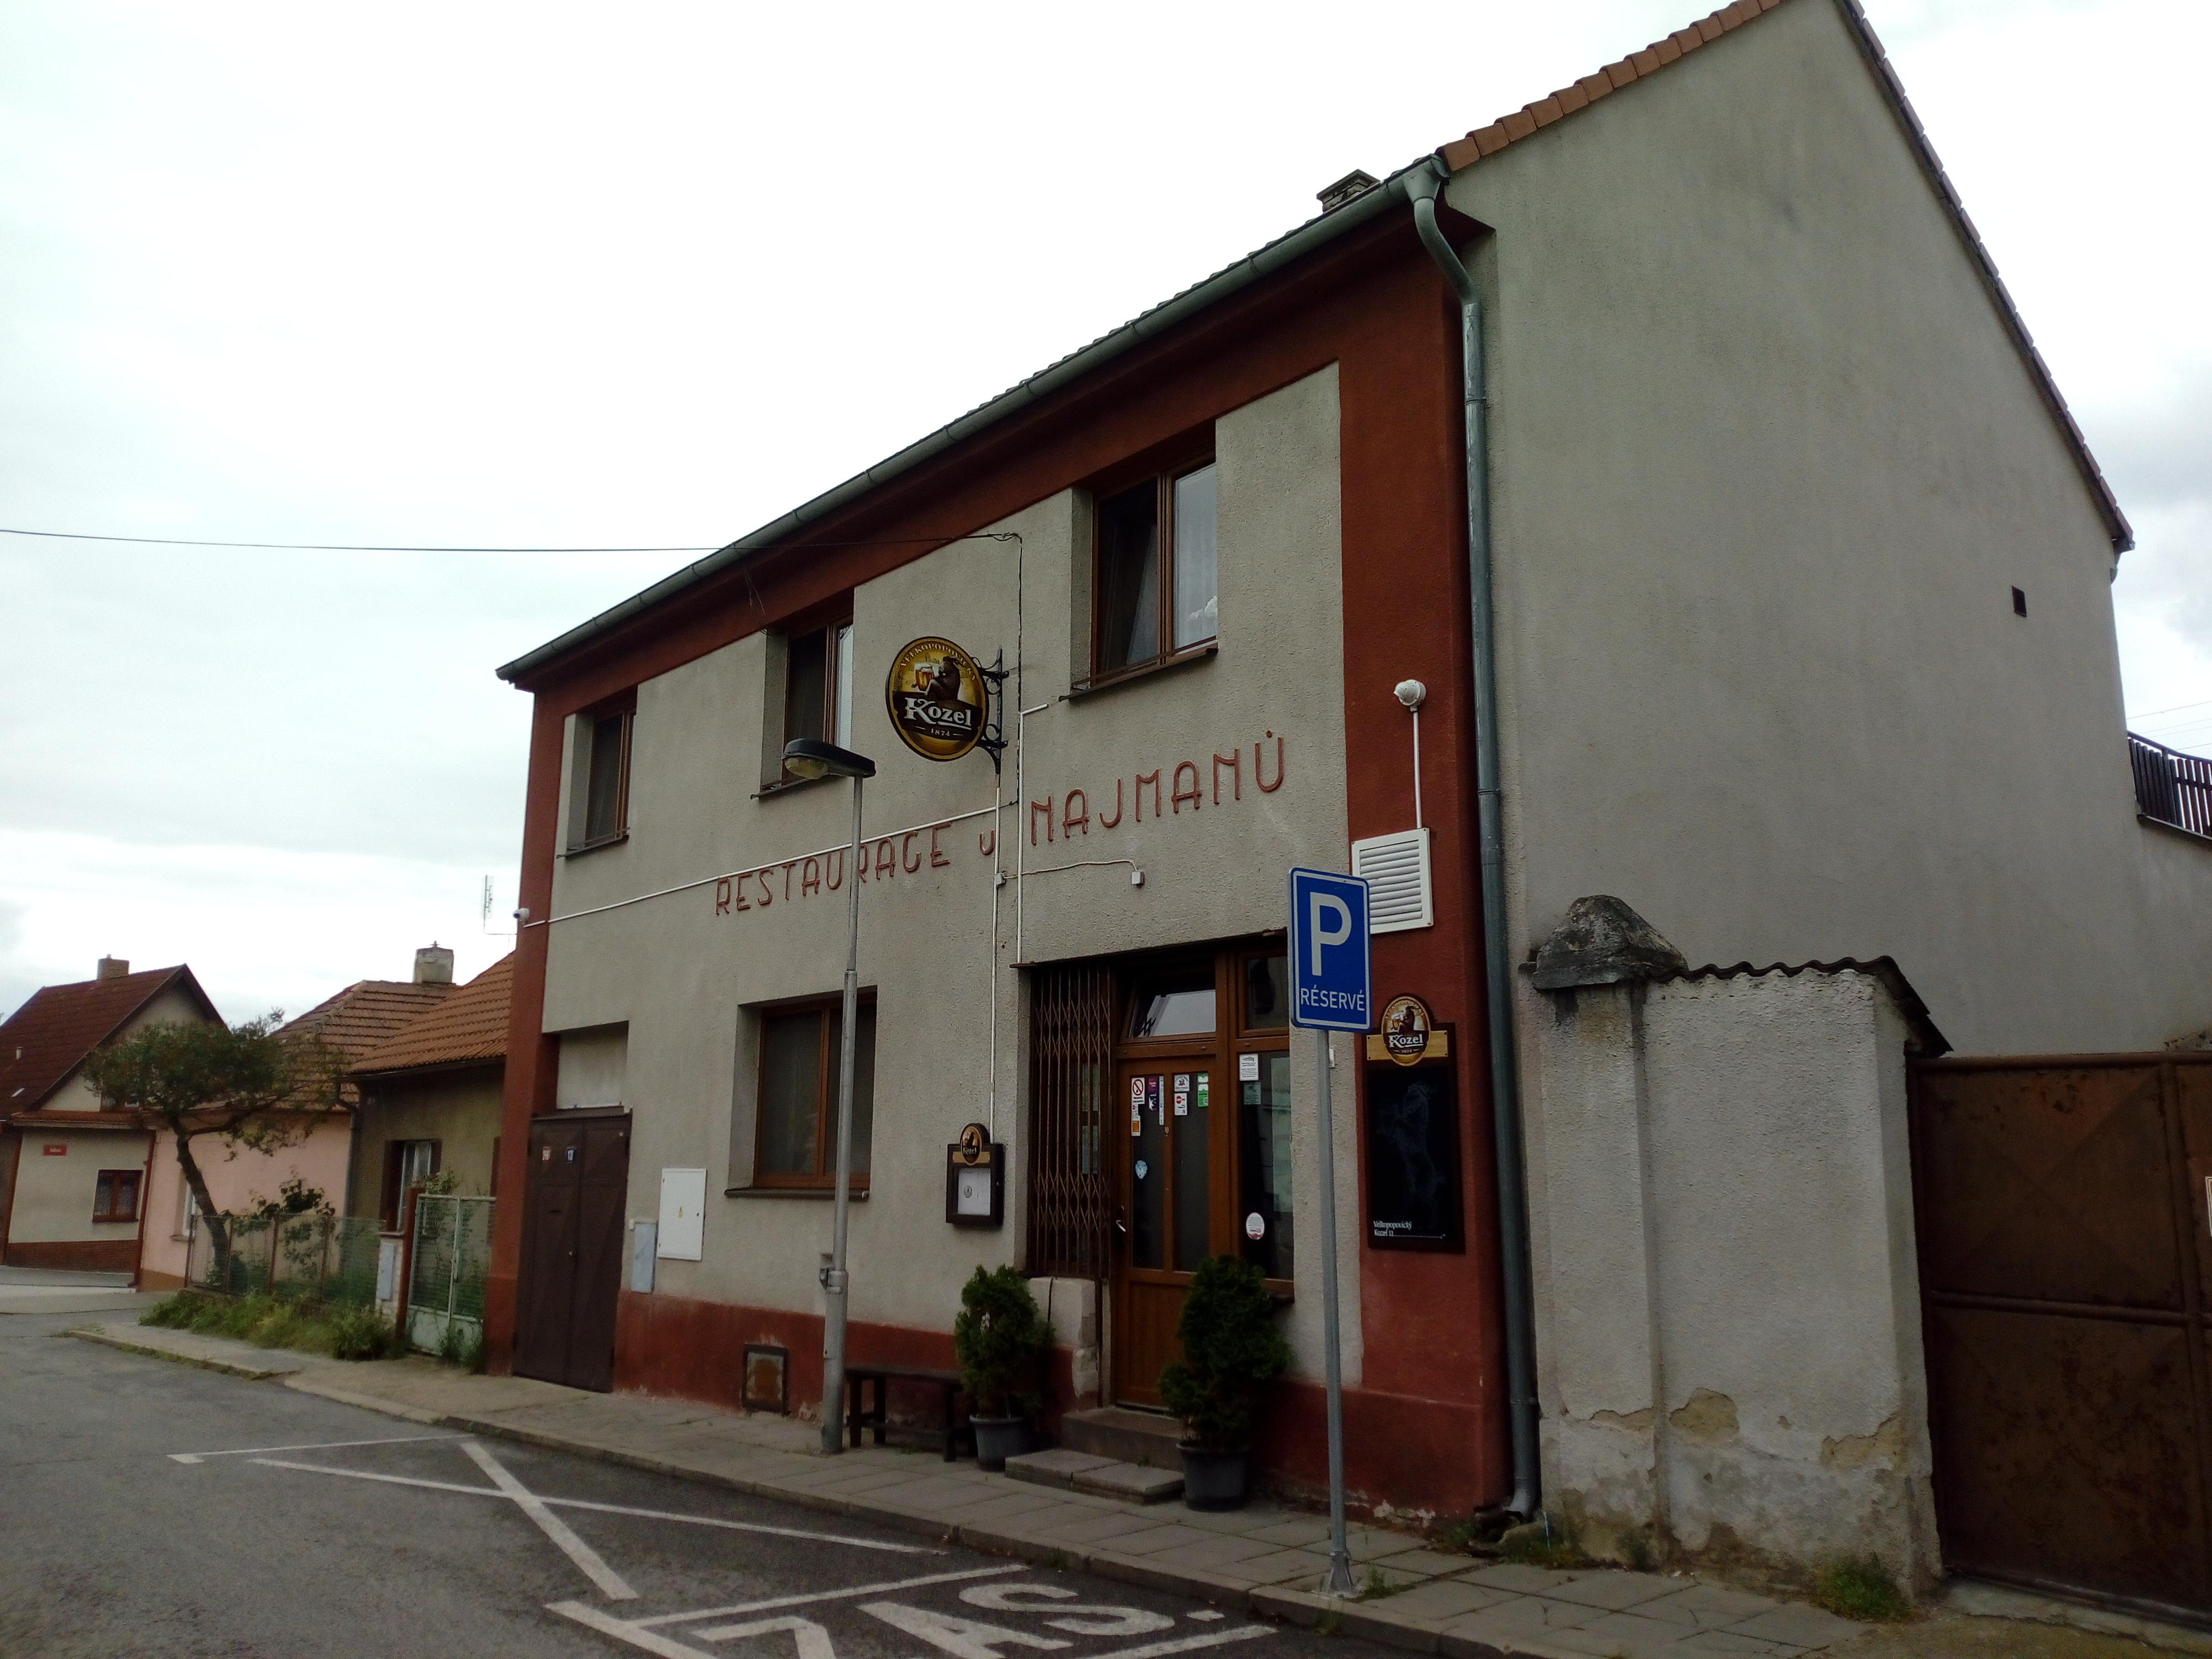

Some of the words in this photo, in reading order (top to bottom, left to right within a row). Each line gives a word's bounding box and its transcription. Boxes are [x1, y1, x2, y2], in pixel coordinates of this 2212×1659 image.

[904, 697, 972, 727] Kozel
[930, 728, 951, 737] 1874
[715, 821, 952, 916] RESTAURACE
[1310, 891, 1352, 977] P
[1300, 984, 1365, 1011] RÉSERVÉ
[1387, 1033, 1424, 1048] Kozel
